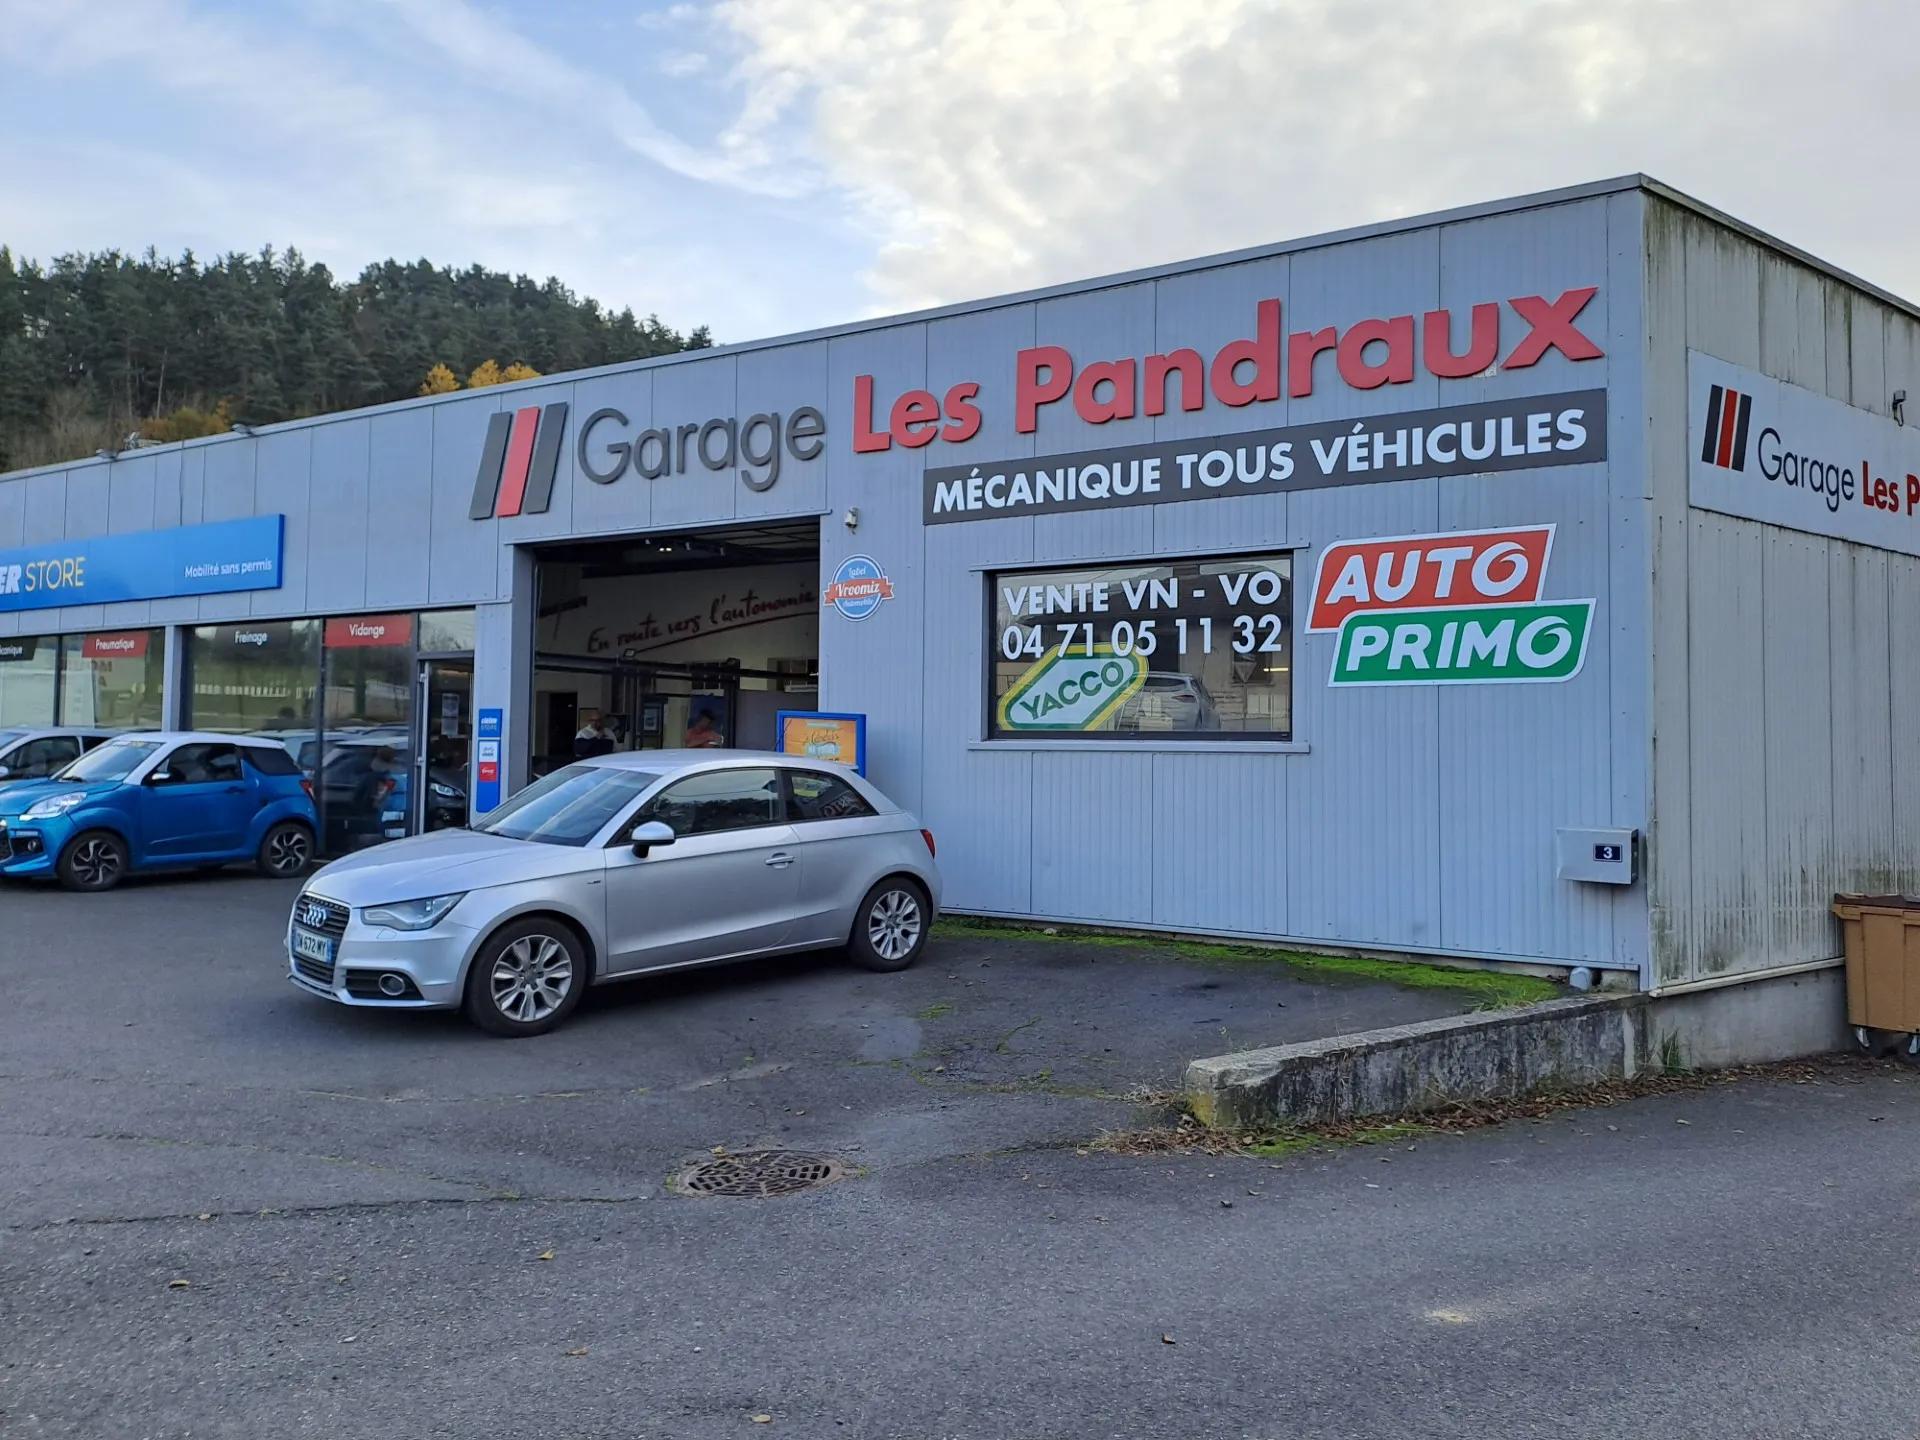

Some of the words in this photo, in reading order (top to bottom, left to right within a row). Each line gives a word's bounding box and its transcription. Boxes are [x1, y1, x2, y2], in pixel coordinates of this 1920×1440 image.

[577, 406, 825, 492] Garage
[853, 375, 982, 453] Les
[1015, 287, 1604, 433] Pandraux
[933, 456, 1161, 513] MÉCANIQUE
[1176, 442, 1295, 489] TOUS
[1310, 409, 1587, 475] VÉHICULES
[1758, 427, 1854, 512] Garage
[1862, 460, 1899, 512] Les
[25, 556, 86, 591] STORE
[184, 562, 219, 578] Mobilité
[221, 564, 239, 575] sans
[241, 558, 273, 576] permis
[836, 581, 880, 597] Vroomiz
[1324, 541, 1528, 604] AUTO
[1003, 582, 1109, 616] VENTE
[1121, 578, 1179, 610] VN
[1219, 571, 1281, 605] VO
[95, 638, 135, 652] Pneumatique
[234, 630, 268, 646] Freinage
[349, 623, 385, 639] Vidange
[587, 627, 610, 654] En
[617, 612, 663, 647] route
[668, 614, 702, 634] vers
[1002, 624, 1044, 660] 04
[1056, 622, 1094, 657] 71
[1111, 620, 1157, 657] 05
[1175, 617, 1212, 655] 11
[1232, 614, 1282, 654] 32
[1346, 616, 1572, 671] PRIMO
[1019, 661, 1124, 720] YACCO
[1603, 847, 1613, 859] 3
